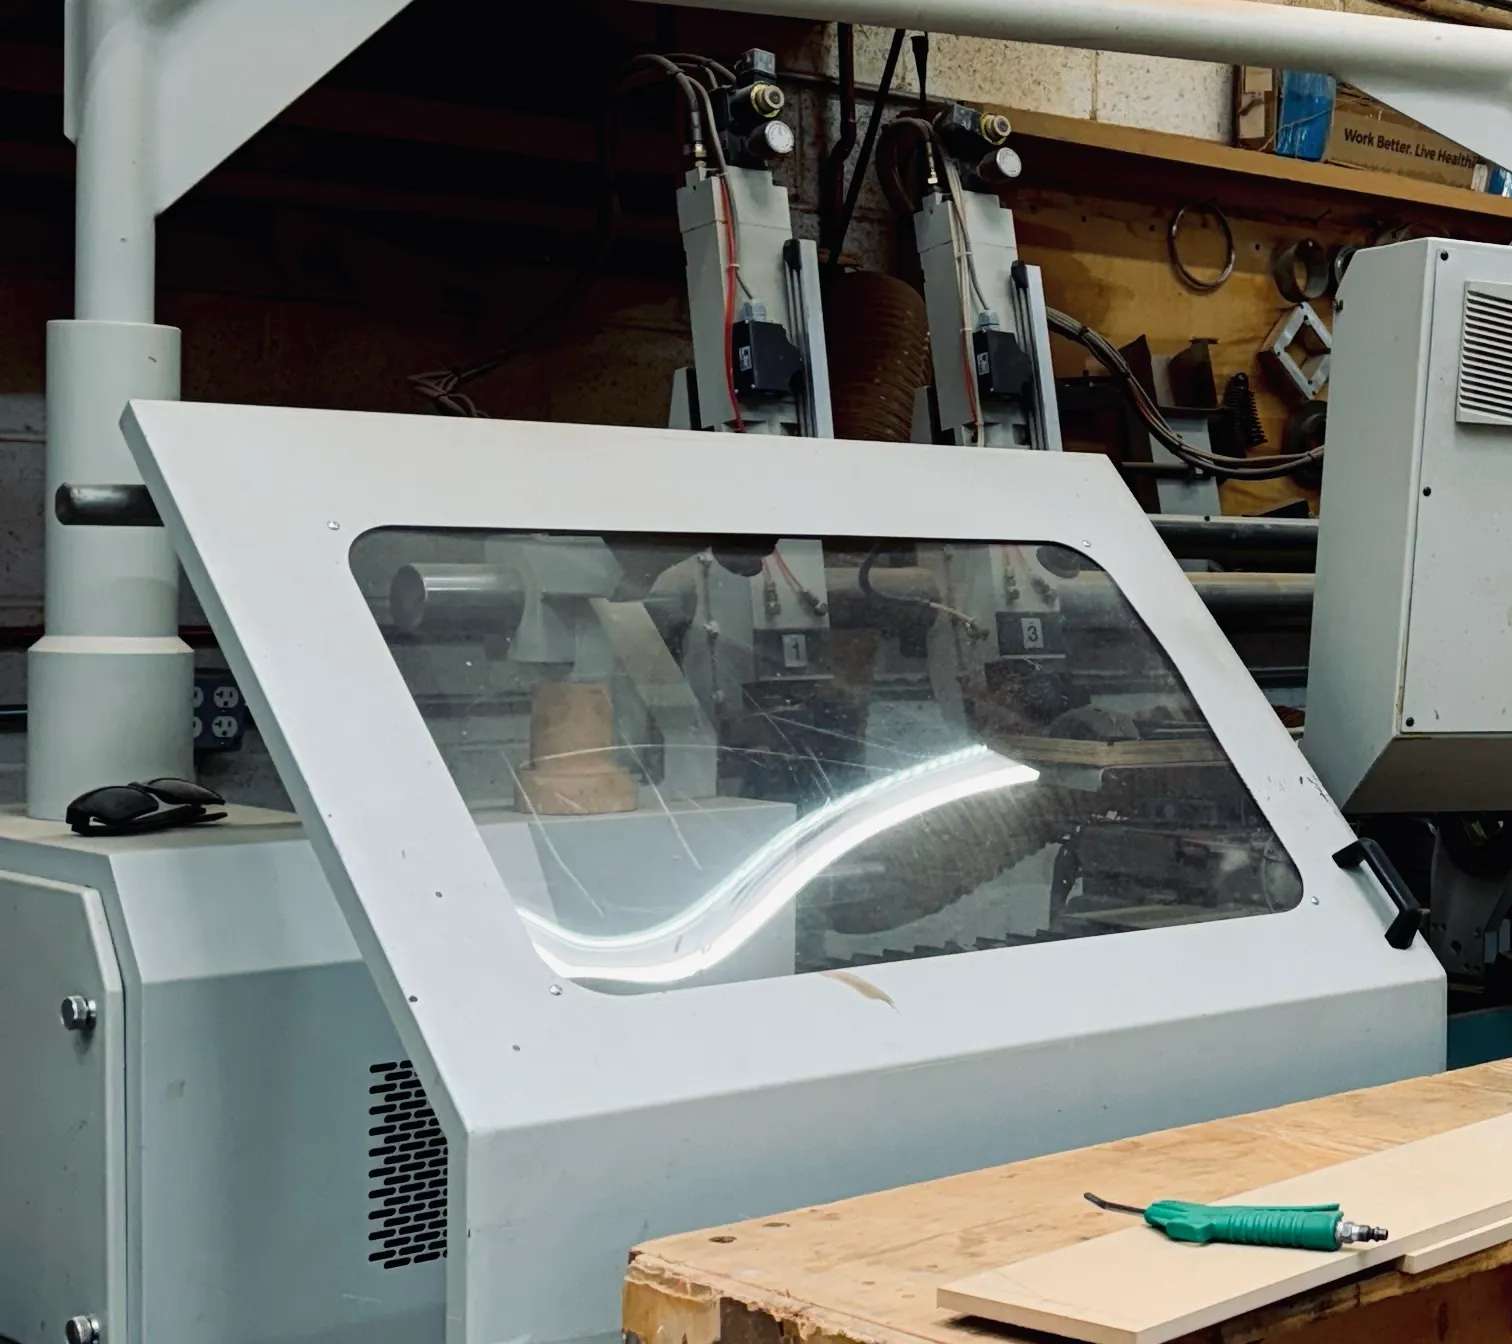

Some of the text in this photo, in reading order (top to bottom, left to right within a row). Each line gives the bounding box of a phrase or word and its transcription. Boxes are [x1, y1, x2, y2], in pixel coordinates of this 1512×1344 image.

[1344, 127, 1476, 169] Work Better. Live Healthi
[1027, 625, 1038, 641] 3
